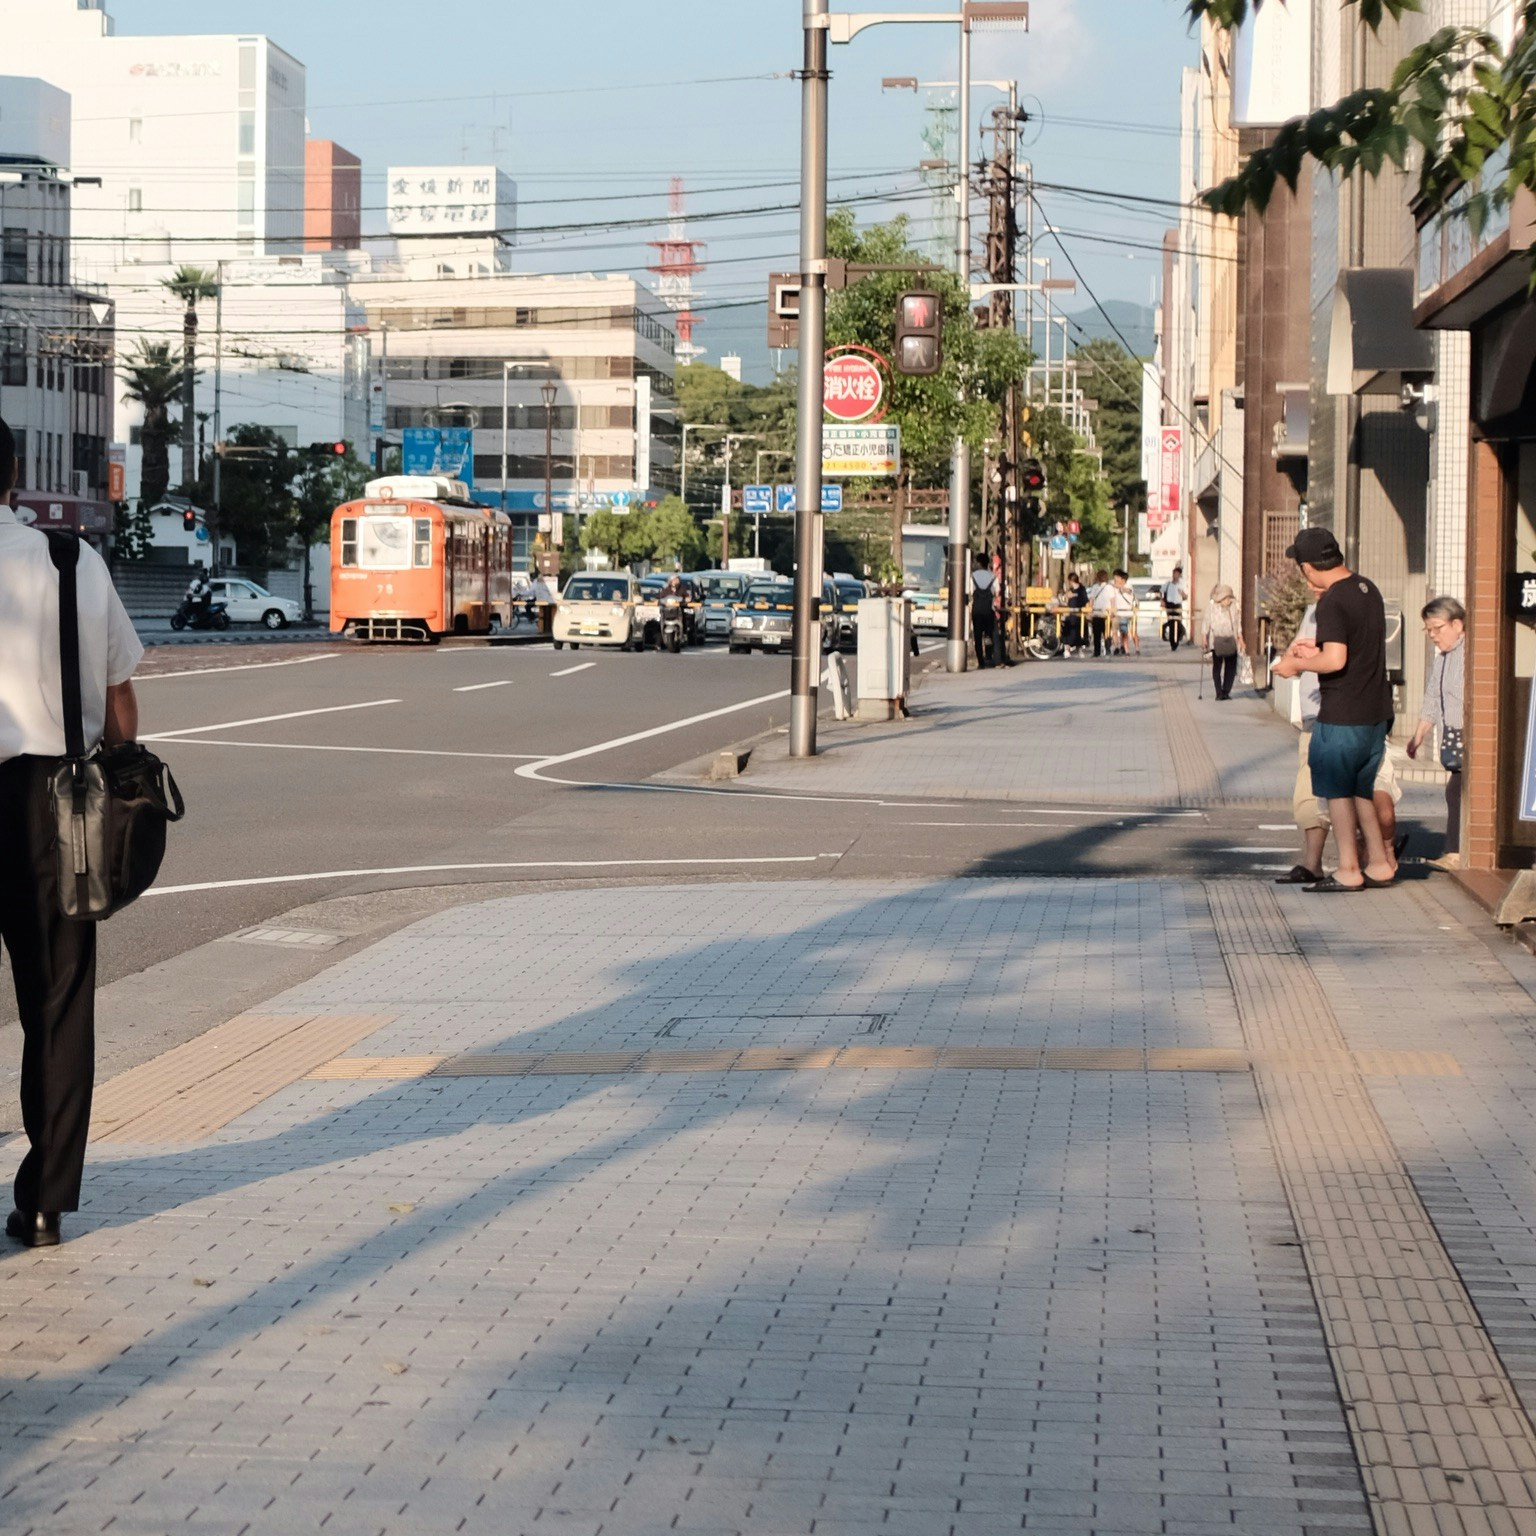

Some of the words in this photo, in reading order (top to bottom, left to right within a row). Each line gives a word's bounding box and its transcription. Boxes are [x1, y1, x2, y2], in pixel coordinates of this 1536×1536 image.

[392, 178, 490, 195] 愛媛新聞
[824, 375, 876, 401] 消火栓
